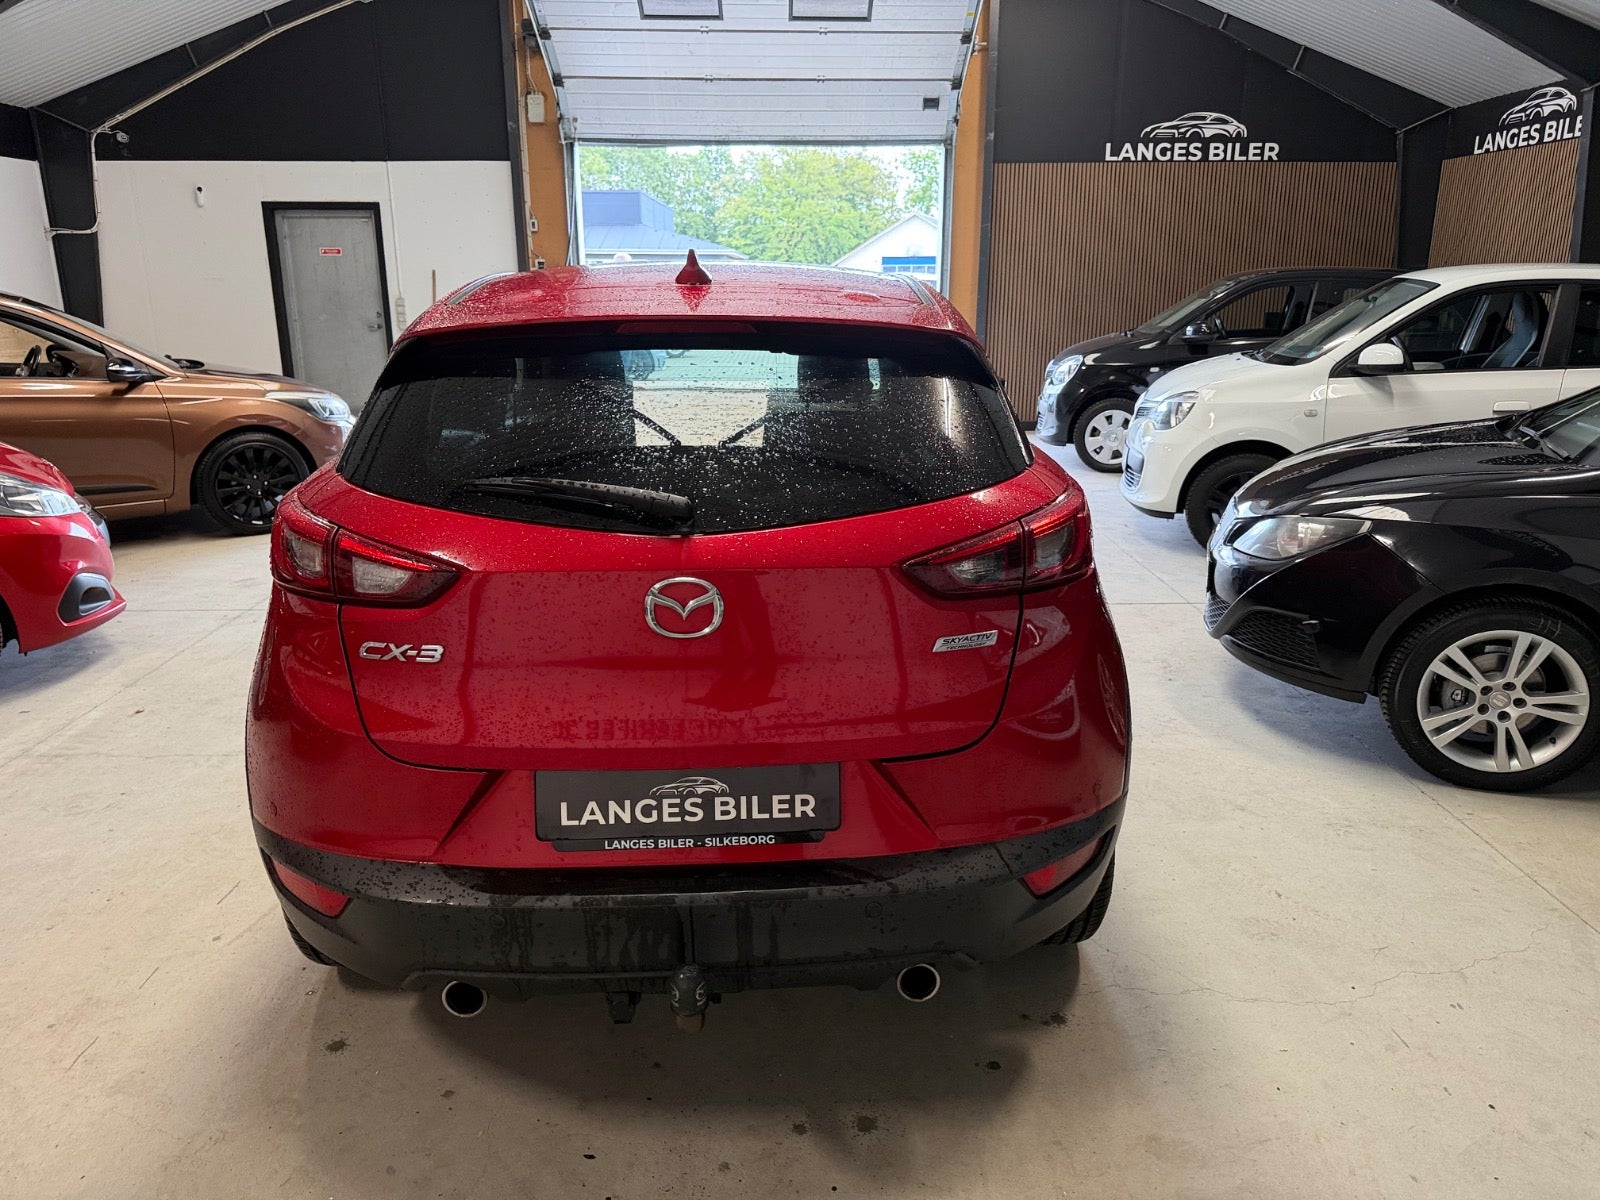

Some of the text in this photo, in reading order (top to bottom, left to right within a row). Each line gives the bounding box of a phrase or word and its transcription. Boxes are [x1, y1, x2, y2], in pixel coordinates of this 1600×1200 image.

[1473, 123, 1541, 155] LANGES
[1104, 142, 1280, 162] LANGES BILER
[942, 632, 993, 645] SKYACTIV
[359, 641, 445, 663] CX-3
[559, 793, 816, 826] LANGES BILER
[604, 838, 655, 850] LANGES
[657, 837, 694, 849] BILER
[704, 834, 776, 847] SILKEBORG
